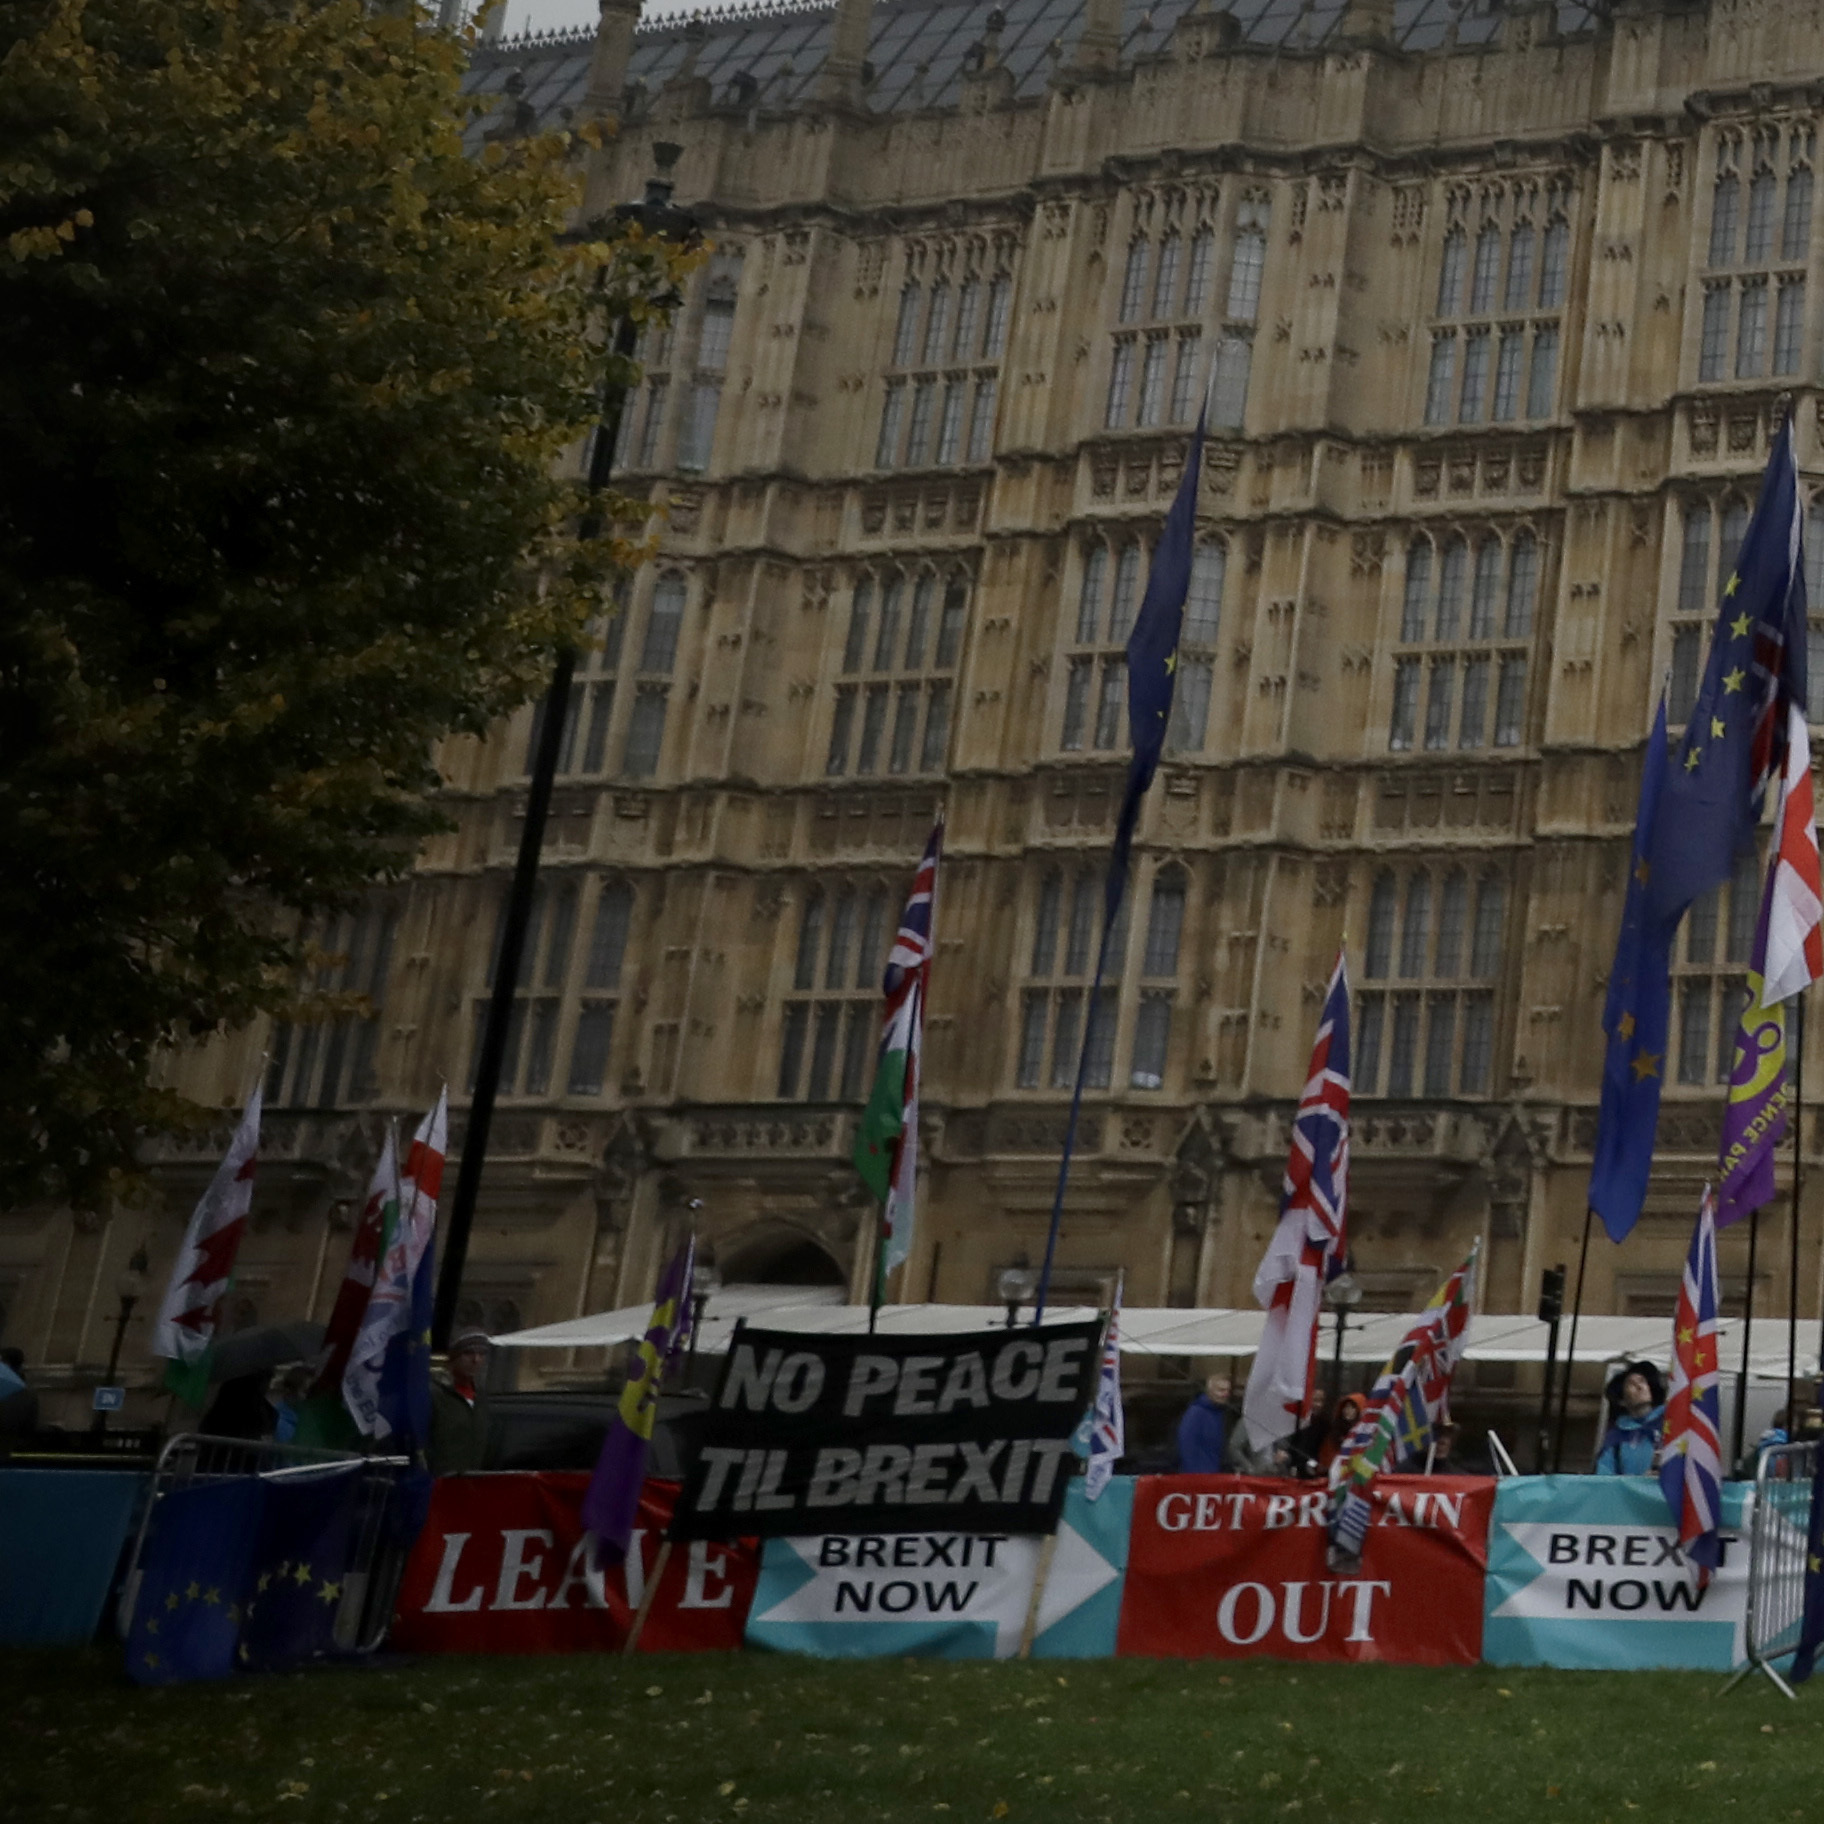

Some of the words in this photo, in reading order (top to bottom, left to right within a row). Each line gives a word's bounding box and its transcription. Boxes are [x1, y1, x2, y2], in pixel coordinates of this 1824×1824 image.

[719, 1343, 827, 1414] NO
[842, 1337, 1089, 1417] PEACE
[696, 1446, 799, 1512] TIL
[806, 1438, 1073, 1507] BREXIT
[1155, 1492, 1256, 1531] GET
[1263, 1491, 1466, 1530] BRAIN
[819, 1536, 1007, 1567] BREXIT
[1549, 1534, 1738, 1567] BREXT
[834, 1581, 979, 1612] NOW
[1216, 1580, 1392, 1645] OUT
[1566, 1579, 1707, 1611] NOW
